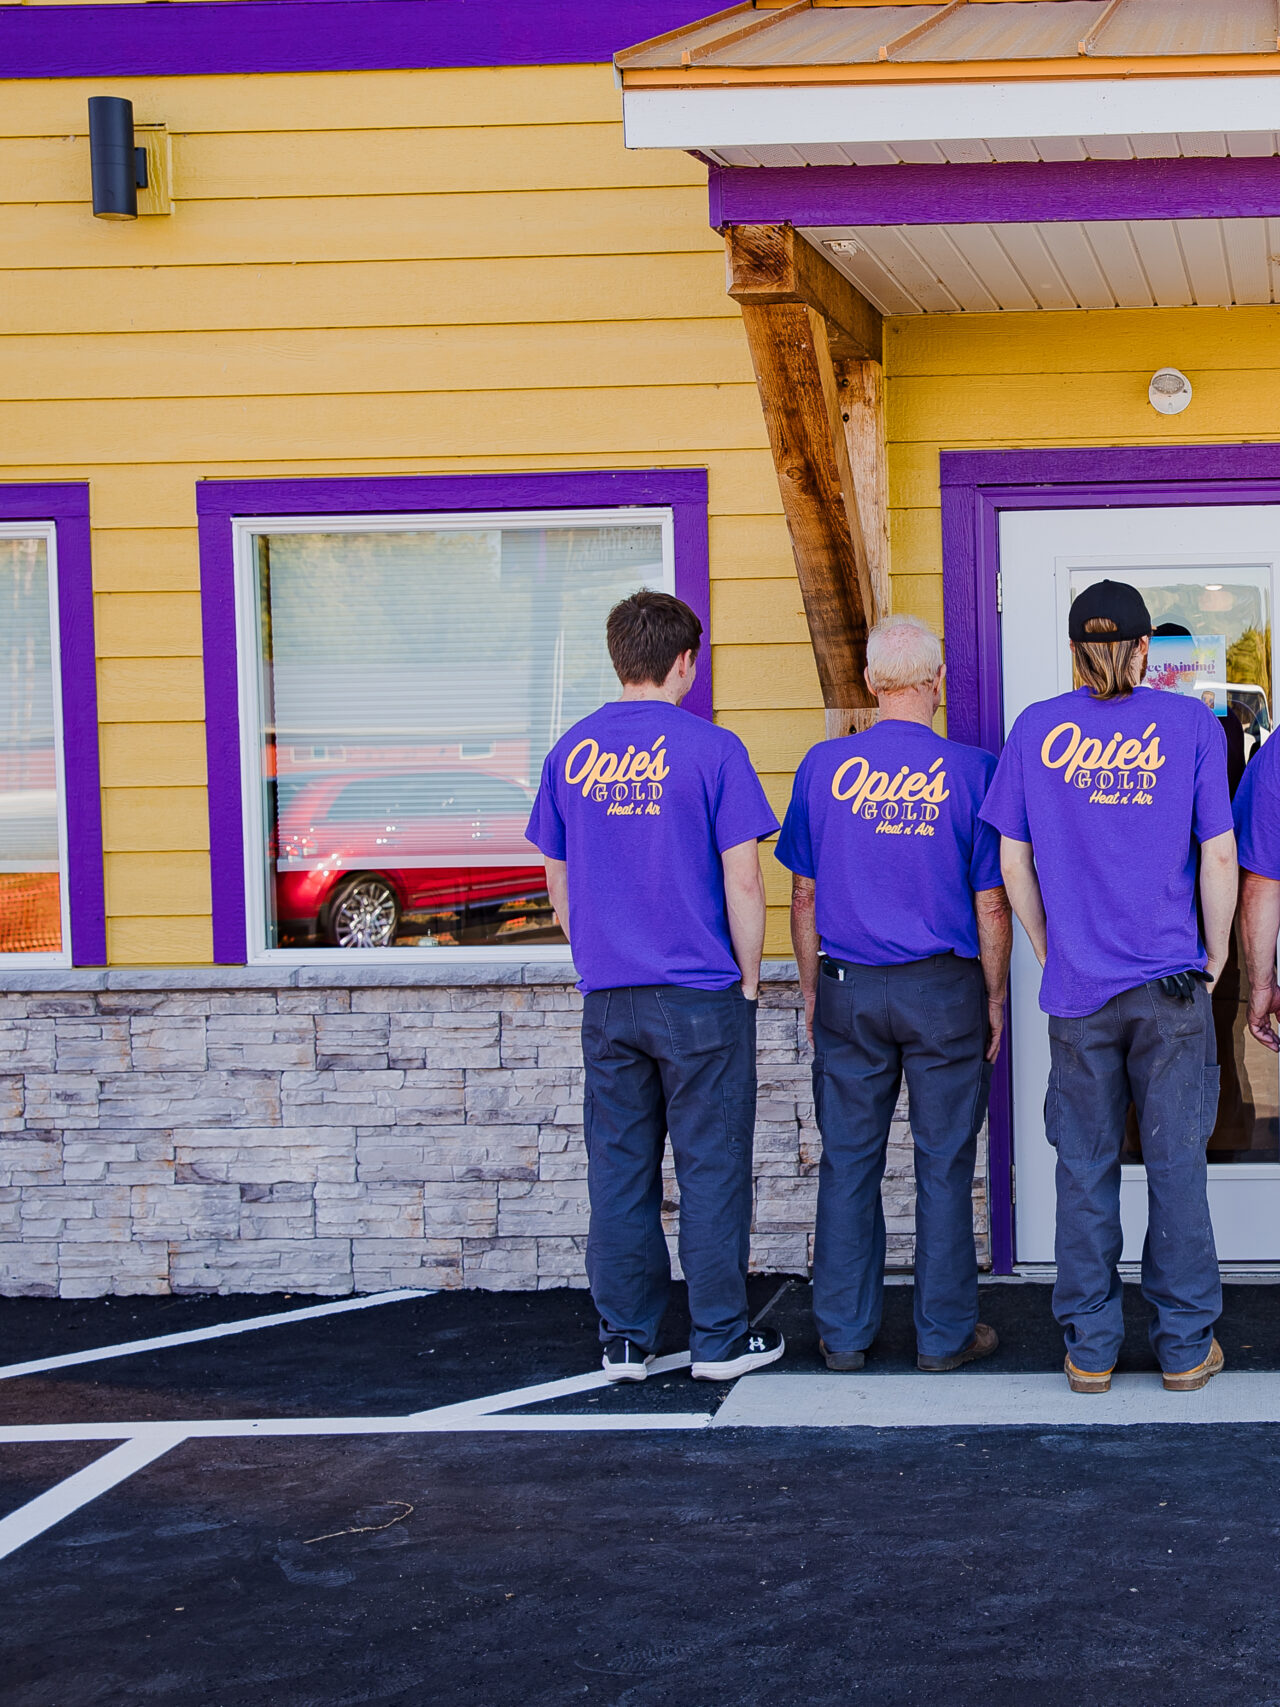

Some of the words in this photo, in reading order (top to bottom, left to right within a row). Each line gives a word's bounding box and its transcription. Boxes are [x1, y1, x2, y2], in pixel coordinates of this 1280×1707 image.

[1040, 722, 1166, 784] Opie's
[564, 735, 671, 798] Opie's
[831, 756, 950, 815] Opie's
[1073, 769, 1157, 790] GOLD
[591, 781, 663, 802] GOLD
[1088, 789, 1120, 805] Heat
[1131, 790, 1153, 806] Air
[606, 802, 635, 816] Heat
[645, 801, 661, 816] Air
[862, 801, 940, 821] GOLD
[875, 820, 904, 835] Heat
[914, 821, 935, 837] Air
